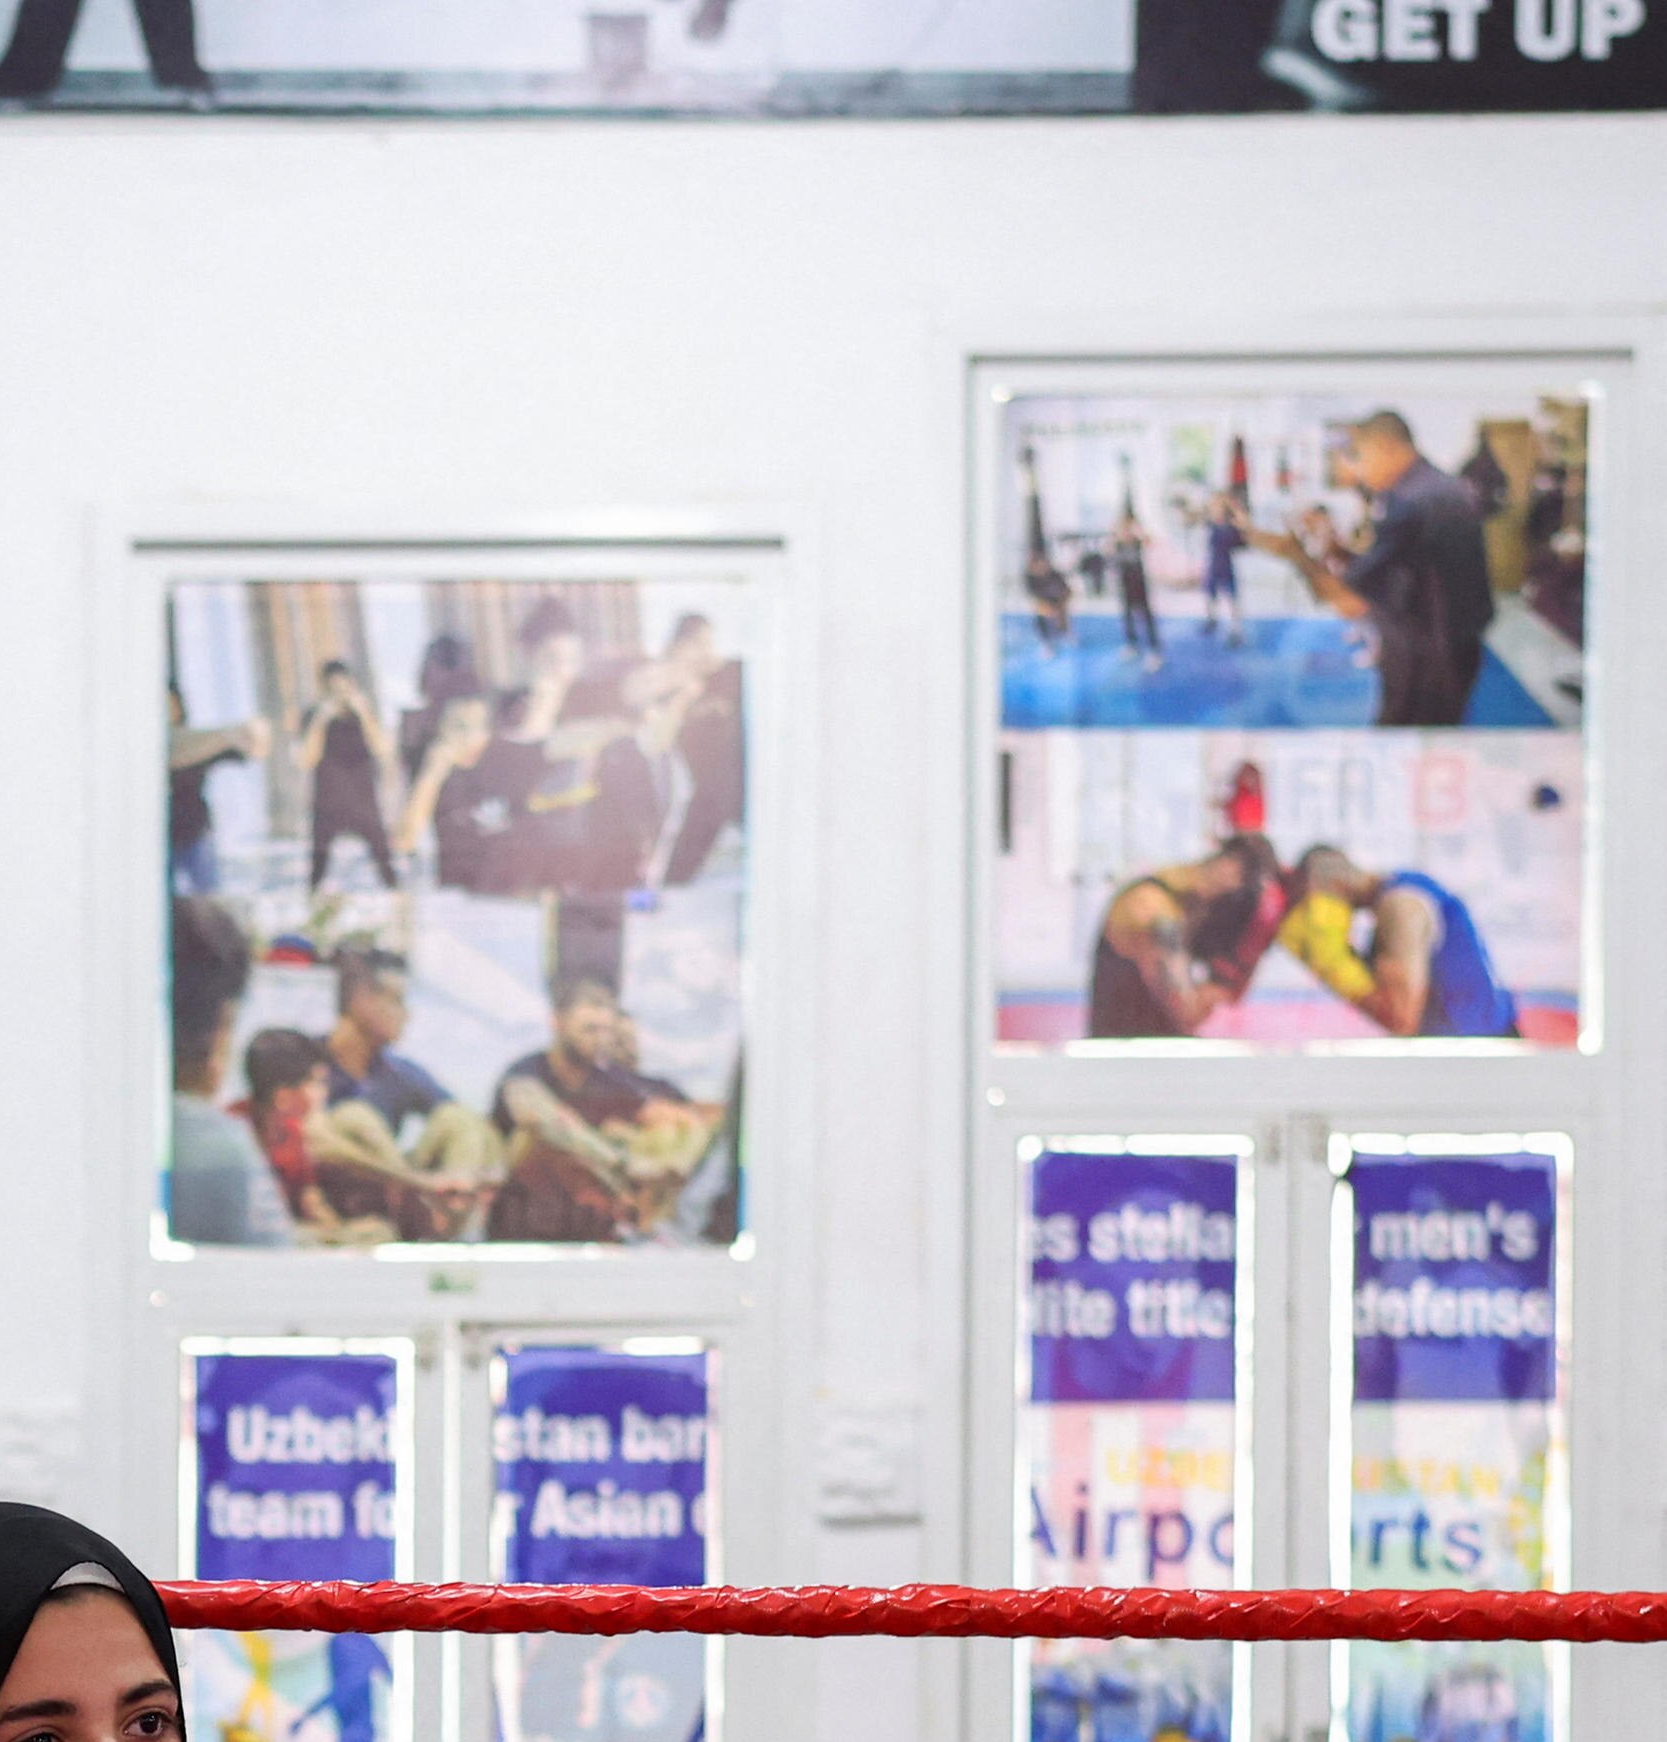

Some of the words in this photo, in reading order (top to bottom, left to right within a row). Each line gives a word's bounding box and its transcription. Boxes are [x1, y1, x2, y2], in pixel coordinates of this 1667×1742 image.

[1312, 0, 1492, 62] GET
[1514, 0, 1646, 61] UP
[1369, 1199, 1539, 1263] men's
[208, 1480, 344, 1539] team
[531, 1478, 684, 1539] Asian
